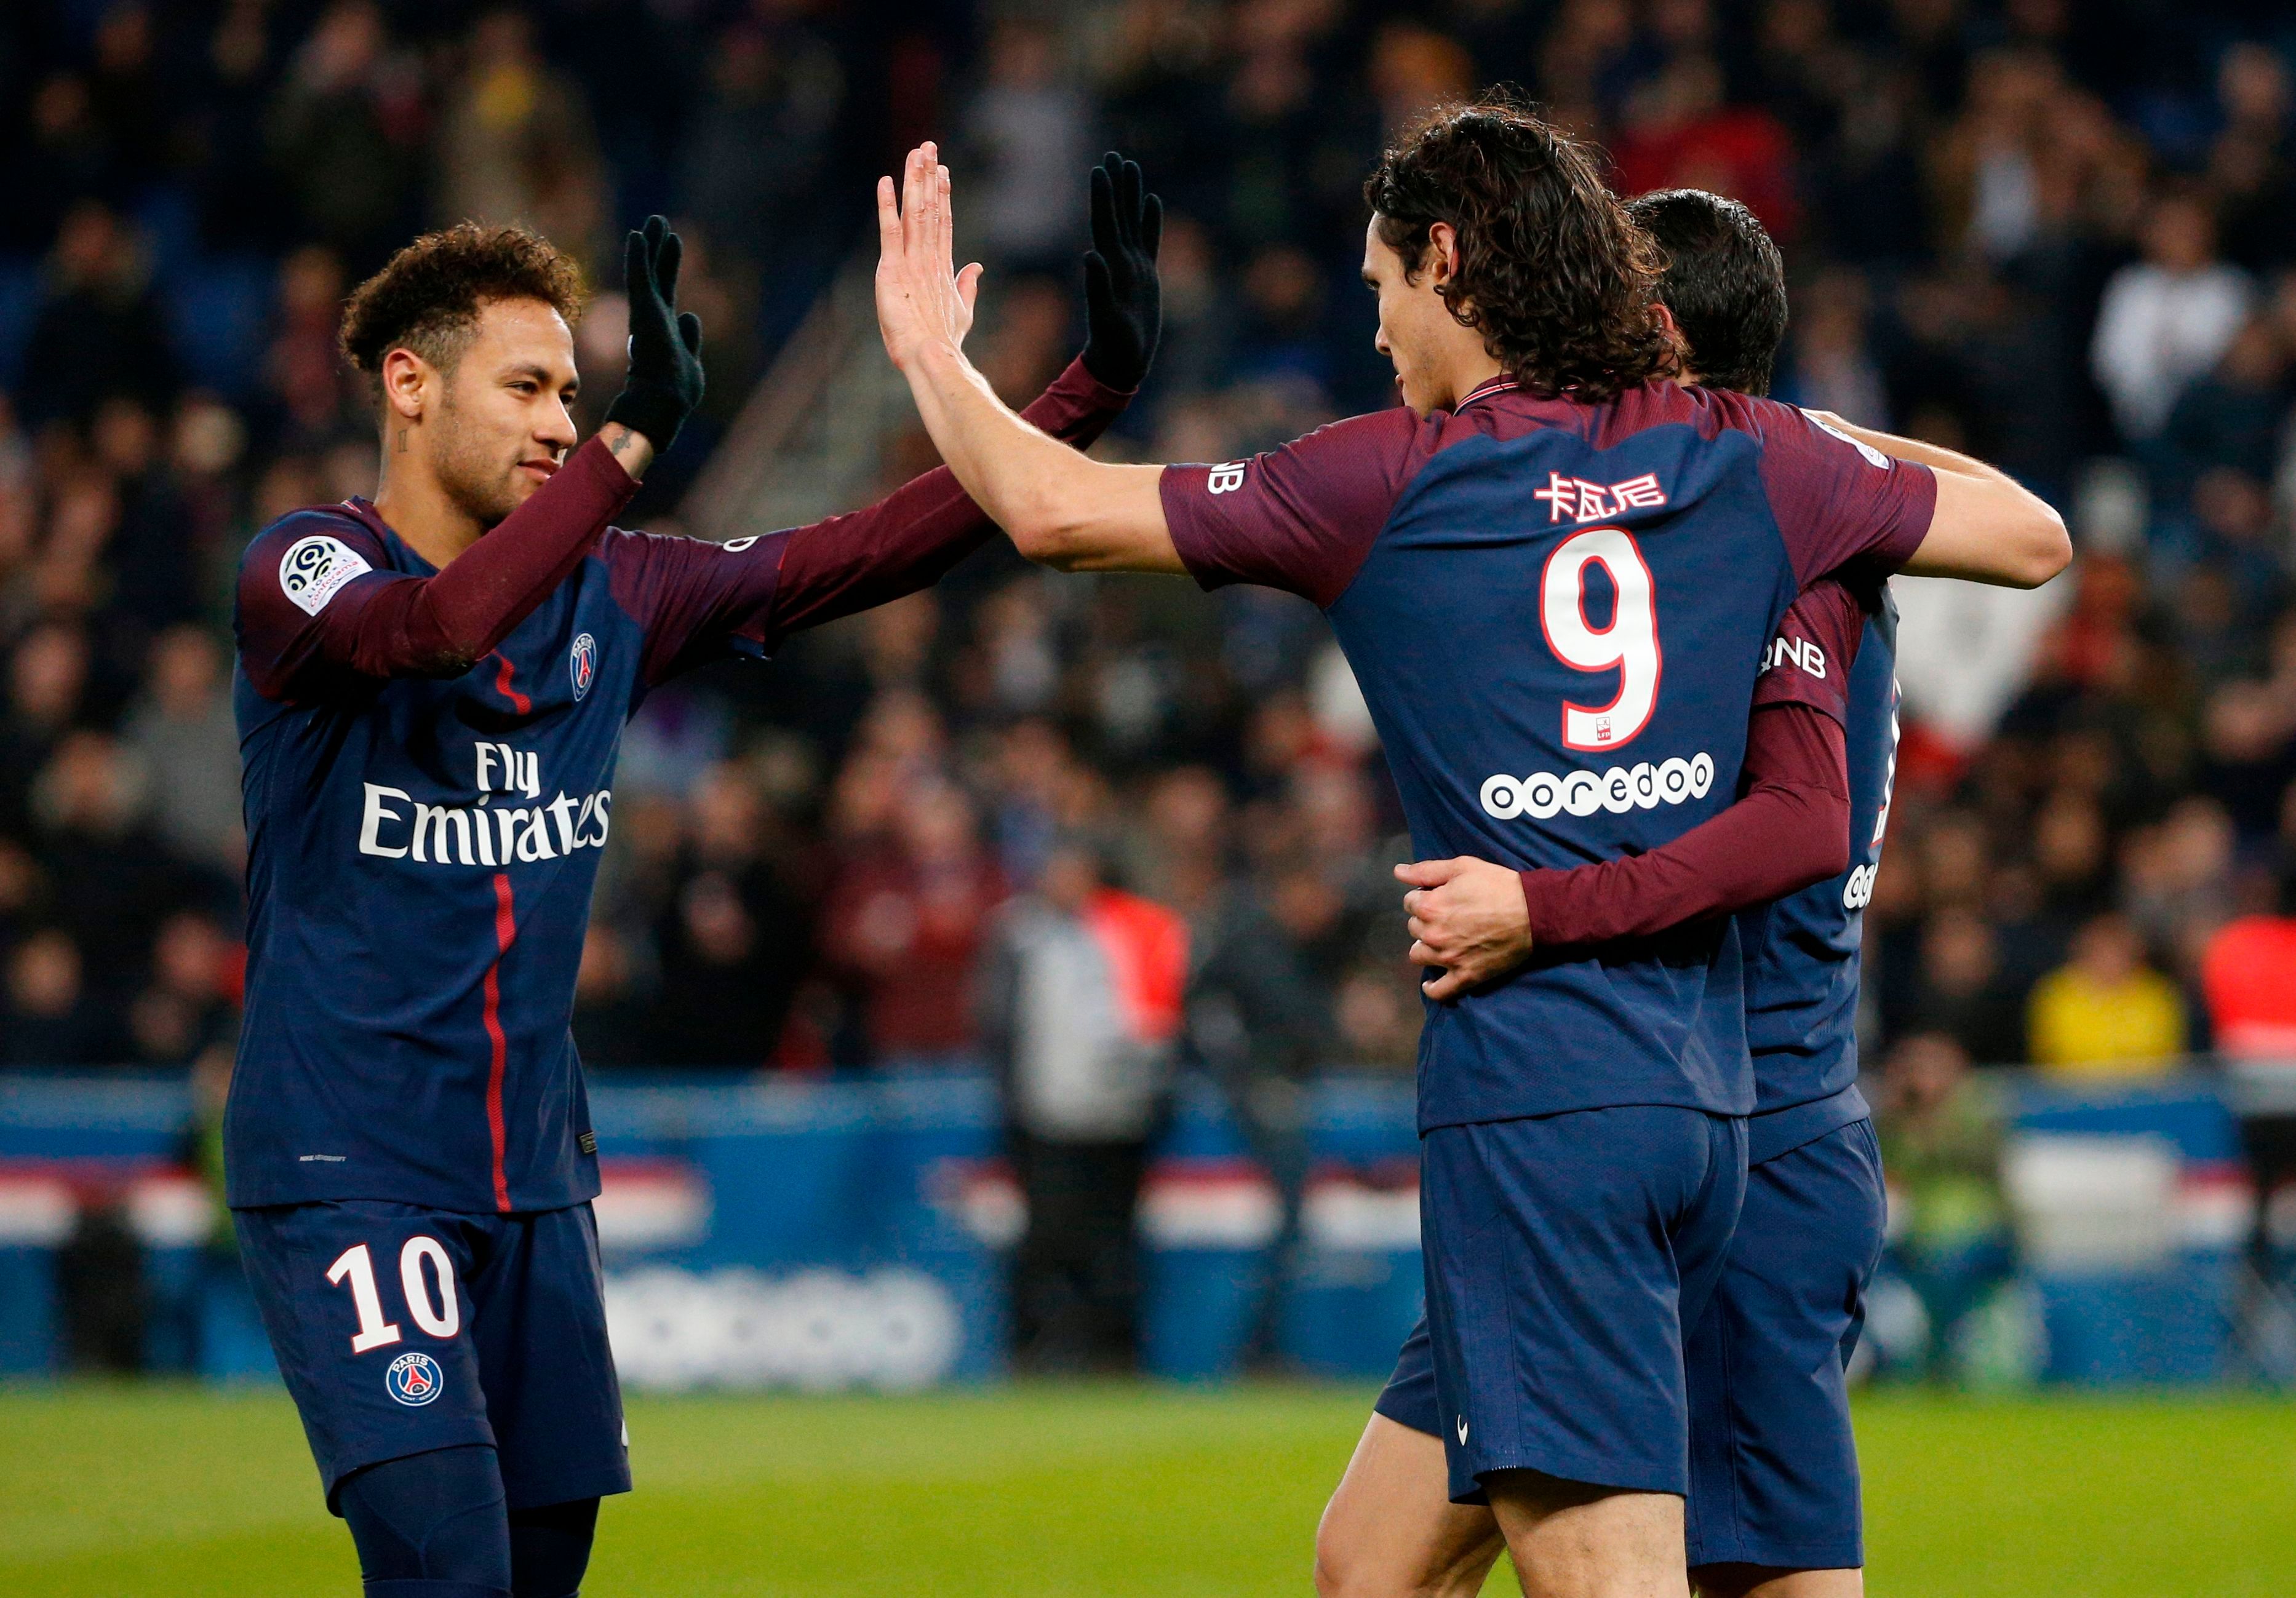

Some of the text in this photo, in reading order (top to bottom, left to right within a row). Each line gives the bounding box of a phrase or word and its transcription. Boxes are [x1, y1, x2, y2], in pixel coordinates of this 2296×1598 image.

[1534, 471, 1668, 524] 卡瓦尼
[310, 560, 359, 607] Conforama
[1539, 526, 1662, 752] 9
[474, 741, 541, 799] Fly
[1481, 753, 1714, 818] ooredoo
[359, 782, 612, 866] Emirates
[325, 1235, 460, 1354] 10
[392, 1356, 429, 1372] PARIS
